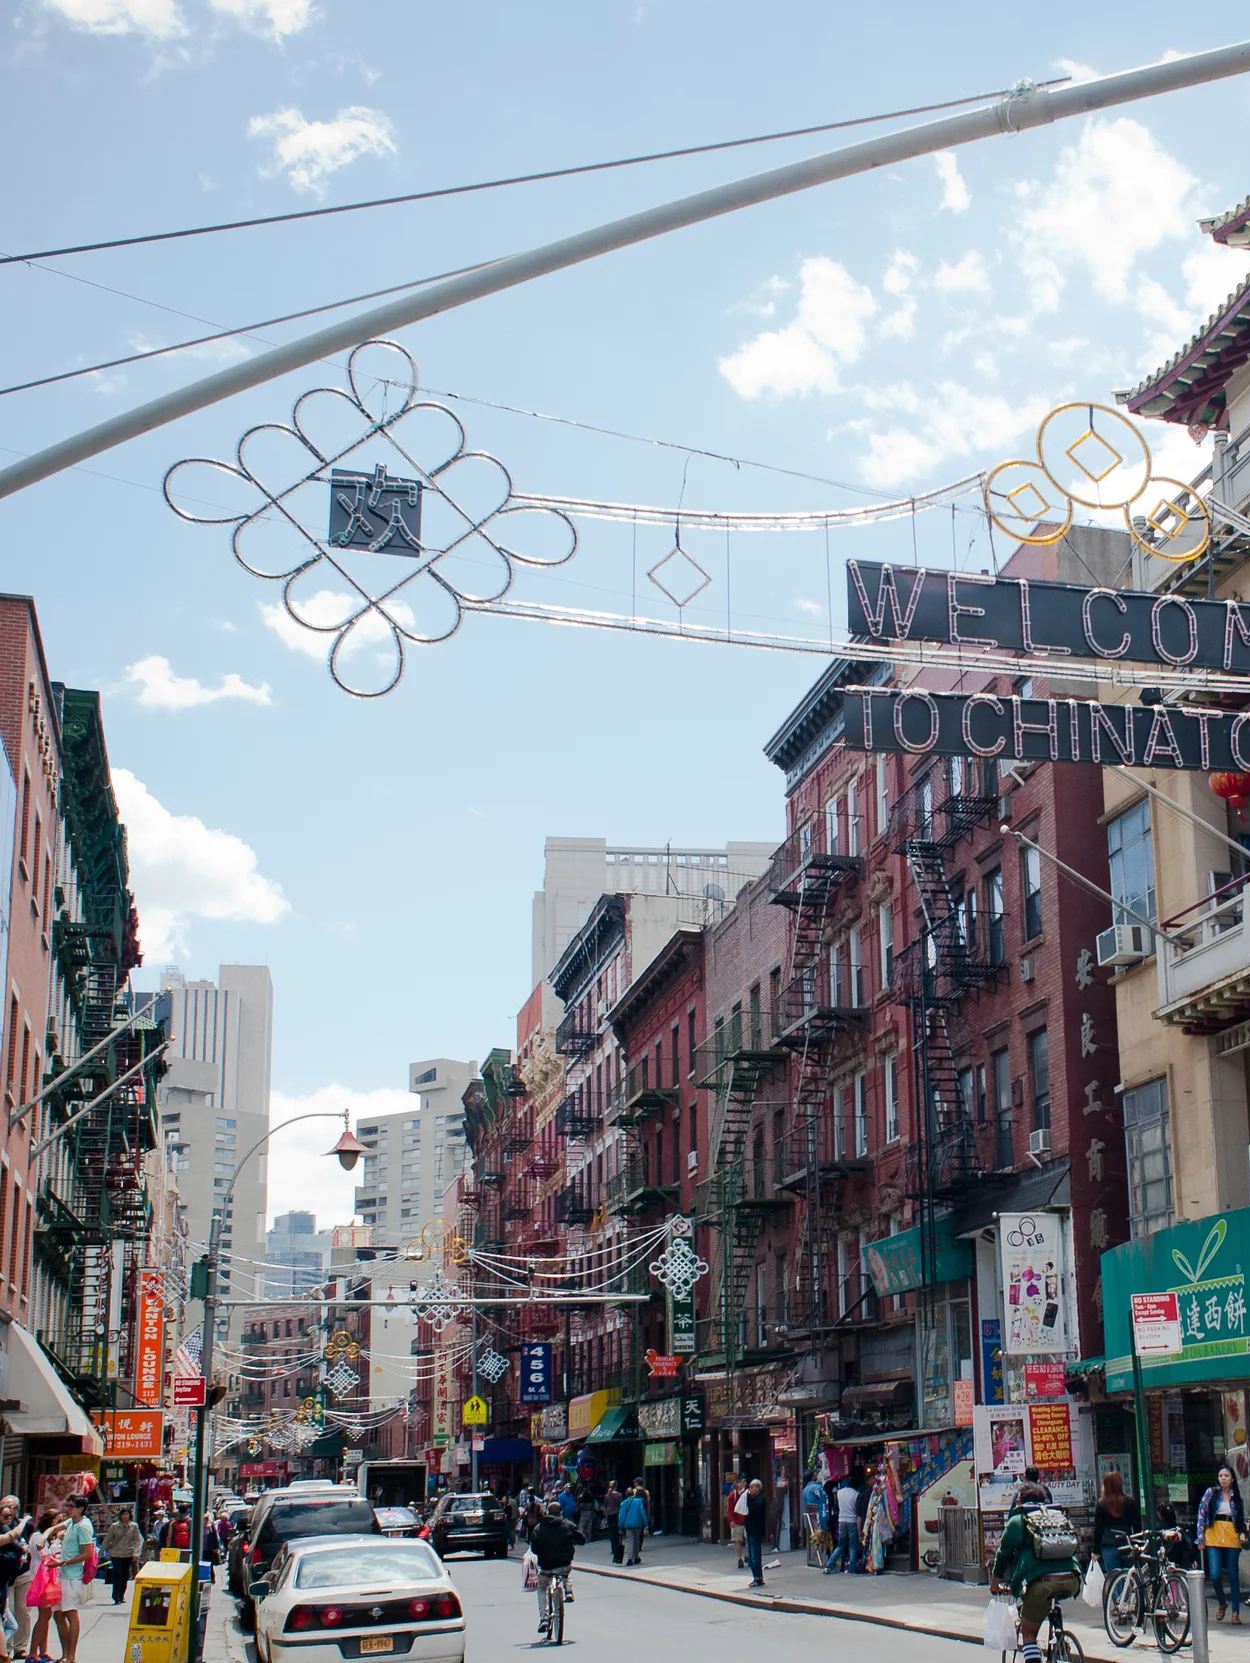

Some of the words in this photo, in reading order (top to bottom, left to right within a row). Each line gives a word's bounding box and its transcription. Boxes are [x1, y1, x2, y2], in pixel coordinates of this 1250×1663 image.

[330, 462, 425, 552] 欢
[843, 684, 938, 754] TO
[1133, 1296, 1143, 1304] NO
[1143, 1295, 1170, 1303] STANDING
[1178, 1287, 1247, 1340] 達西餅
[1147, 1325, 1171, 1333] PARKING
[143, 1347, 156, 1389] LOUNGE
[685, 1400, 702, 1430] 天仁
[1032, 1425, 1068, 1434] CLEARANCE
[1043, 1481, 1064, 1489] EAUTY
